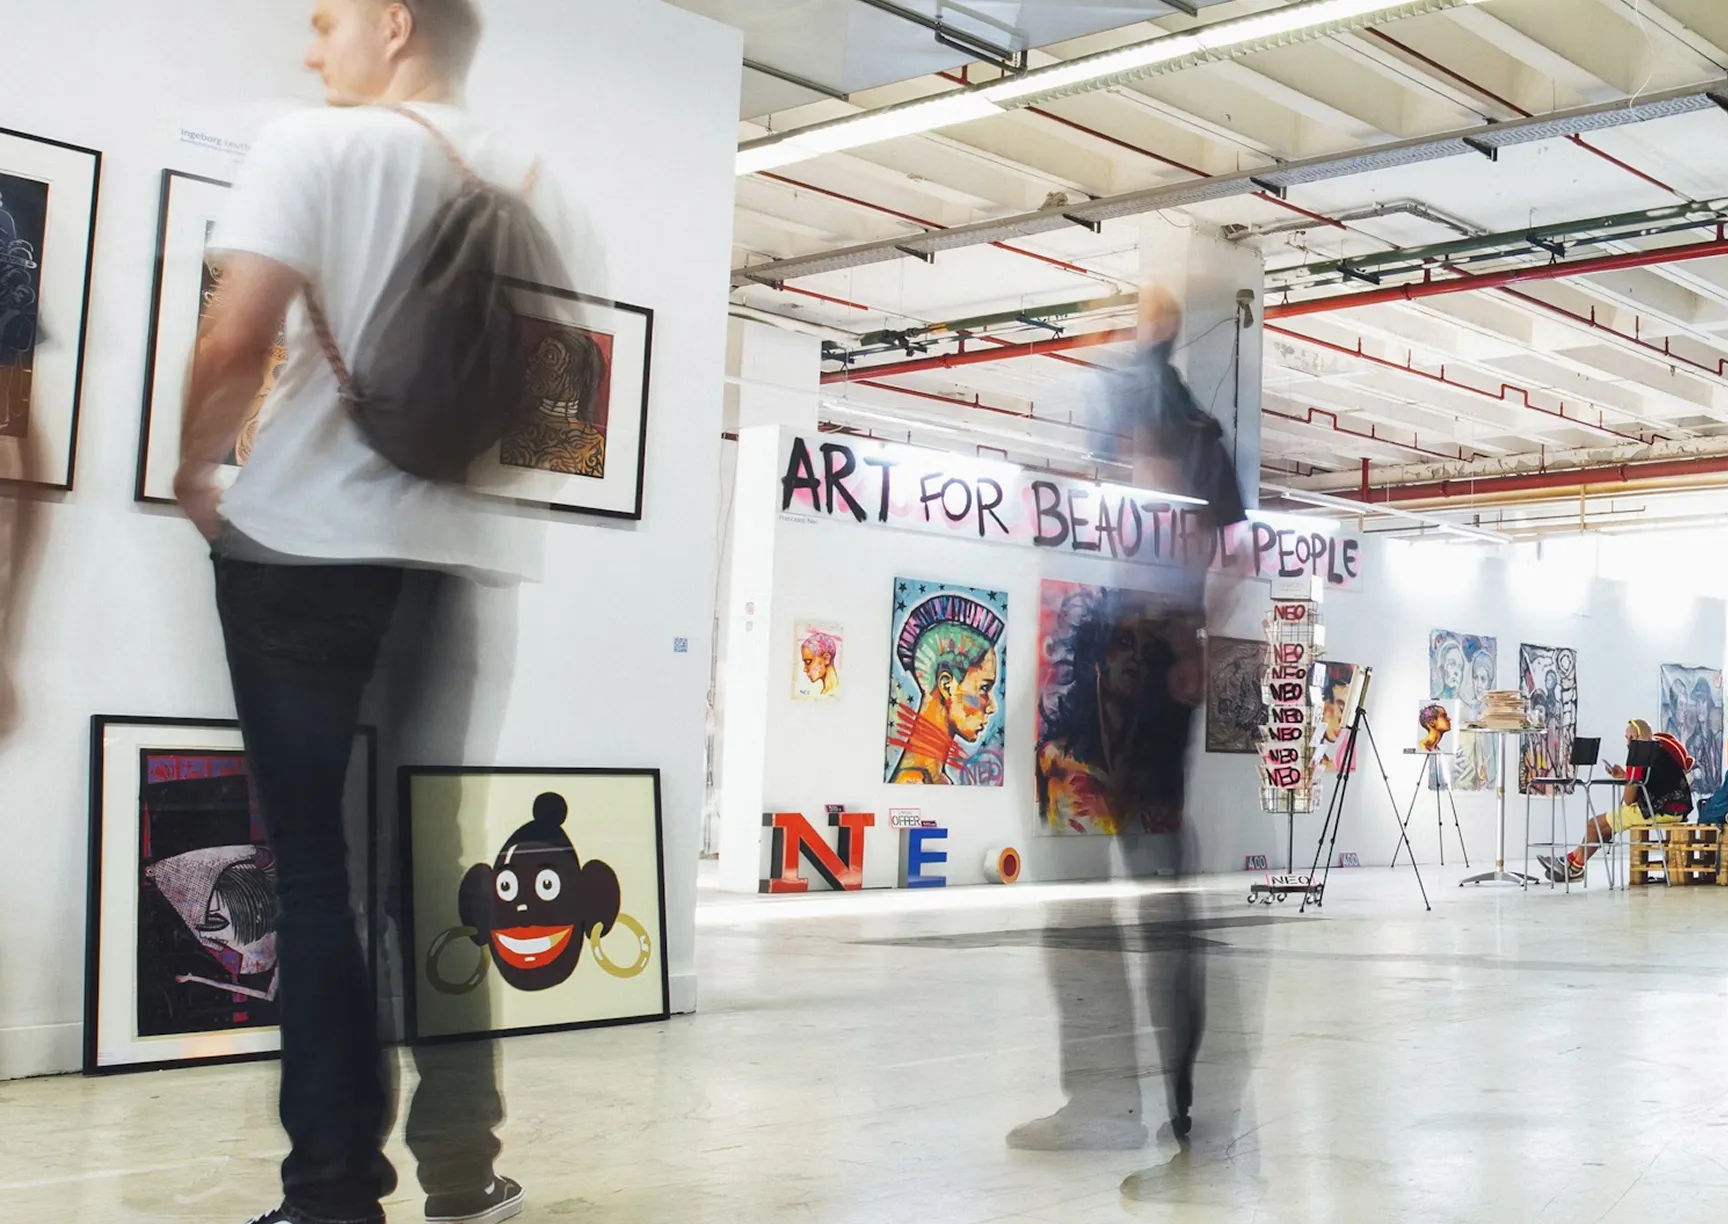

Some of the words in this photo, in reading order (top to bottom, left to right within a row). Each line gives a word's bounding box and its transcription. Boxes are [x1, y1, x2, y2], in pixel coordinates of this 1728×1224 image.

[180, 127, 222, 146] Ingeborg
[782, 437, 896, 523] ART
[920, 472, 1009, 537] FOR
[1252, 522, 1358, 584] PEOPLE
[1274, 604, 1306, 621] NEO
[1274, 643, 1304, 665] NEO
[1272, 665, 1306, 679] NEO
[1270, 683, 1303, 702] NEO
[1272, 708, 1304, 723] NEO
[1269, 727, 1302, 741] NEO
[1269, 749, 1298, 764] NEO
[1266, 767, 1301, 787] NEO
[892, 815, 920, 826] OFFER
[1249, 856, 1267, 869] 400
[1343, 854, 1358, 866] 400
[1271, 875, 1311, 885] NEO
